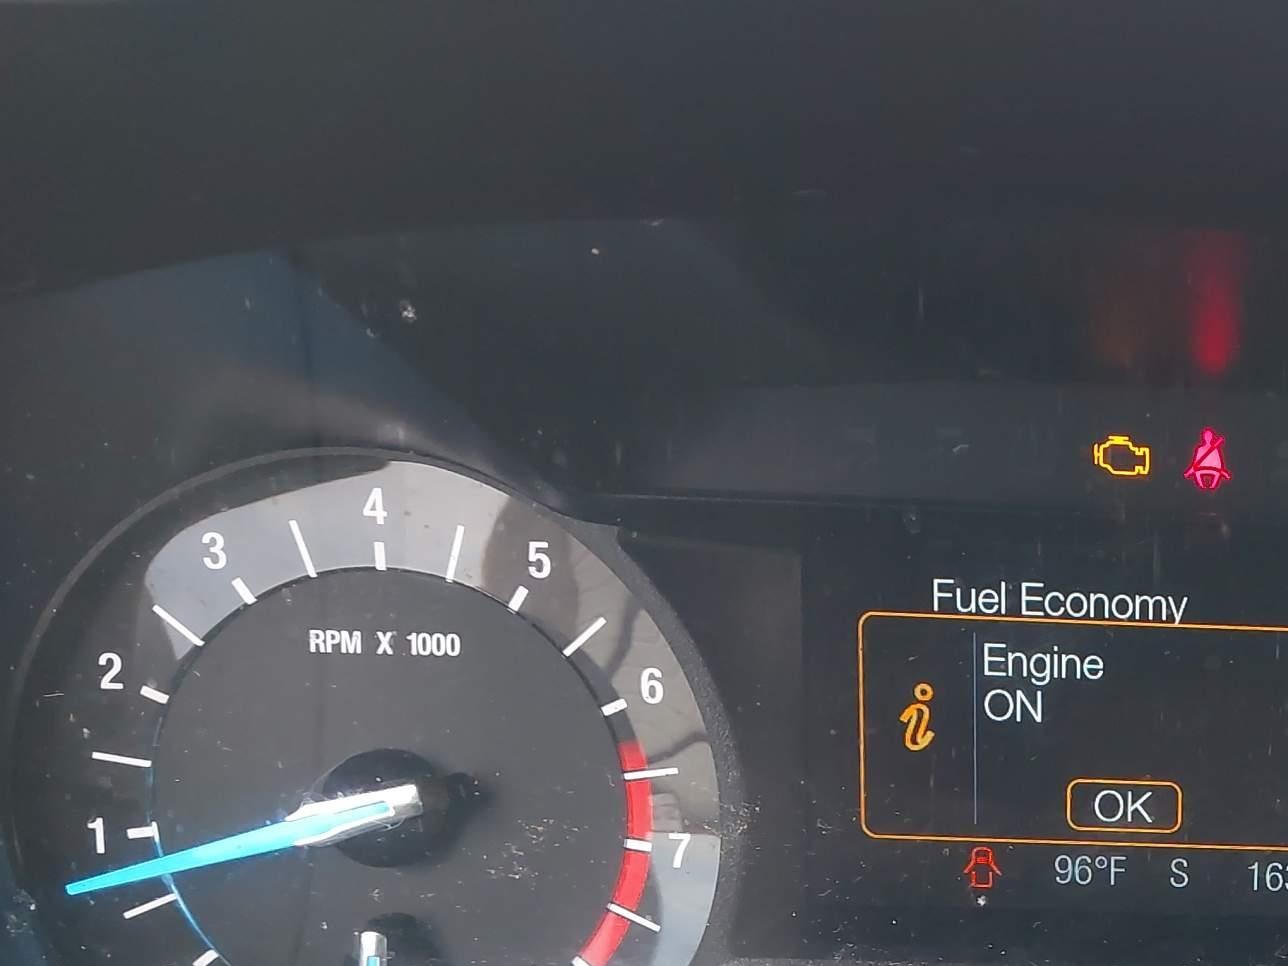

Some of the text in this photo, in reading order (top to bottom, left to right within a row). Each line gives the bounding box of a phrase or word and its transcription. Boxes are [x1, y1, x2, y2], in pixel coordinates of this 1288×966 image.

[363, 488, 387, 524] 4
[202, 532, 226, 569] 3
[529, 542, 550, 578] 5
[931, 578, 1189, 625] Fuel Economy
[310, 630, 460, 656] RPM X 1000
[99, 653, 123, 689] 2
[984, 643, 1103, 685] Engine
[641, 668, 663, 704] 6
[984, 690, 1041, 722] ON
[1095, 791, 1152, 822] OK
[88, 818, 105, 853] 1
[669, 833, 690, 868] 7
[1055, 855, 1126, 885] 96°F
[1171, 859, 1188, 887] S
